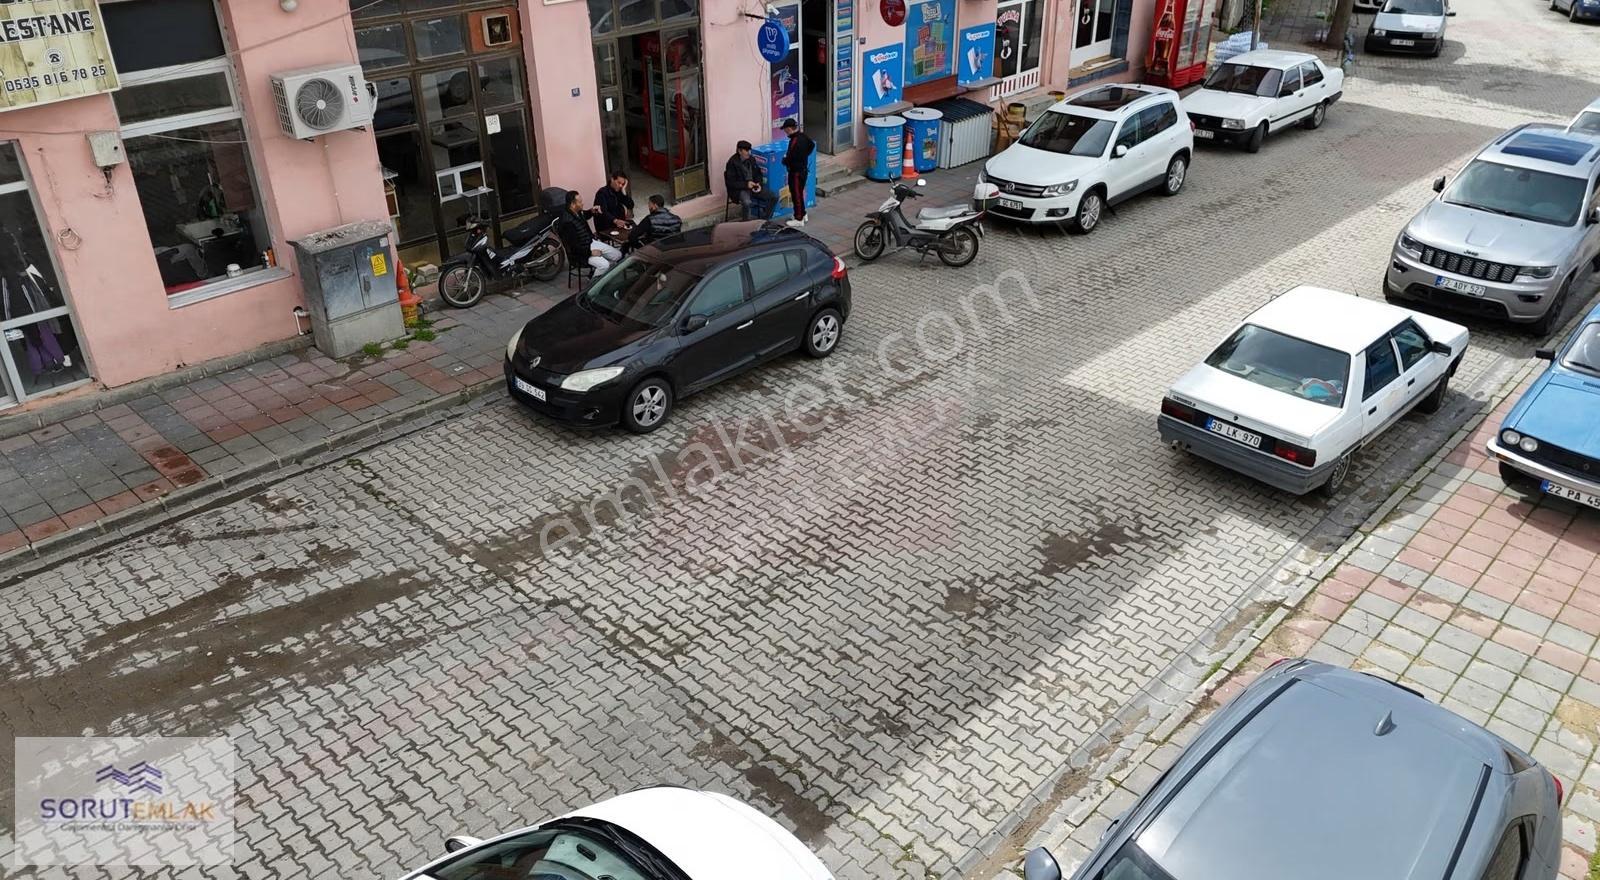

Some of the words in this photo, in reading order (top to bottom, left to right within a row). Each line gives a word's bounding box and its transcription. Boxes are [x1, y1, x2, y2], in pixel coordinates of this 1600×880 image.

[5, 77, 40, 92] 0535
[43, 71, 68, 86] 816
[72, 68, 88, 80] 78
[91, 65, 107, 77] 25
[1211, 421, 1223, 432] 39
[1226, 426, 1239, 438] LK
[1242, 432, 1260, 446] 970
[1548, 483, 1562, 495] 22
[1567, 489, 1581, 500] PA
